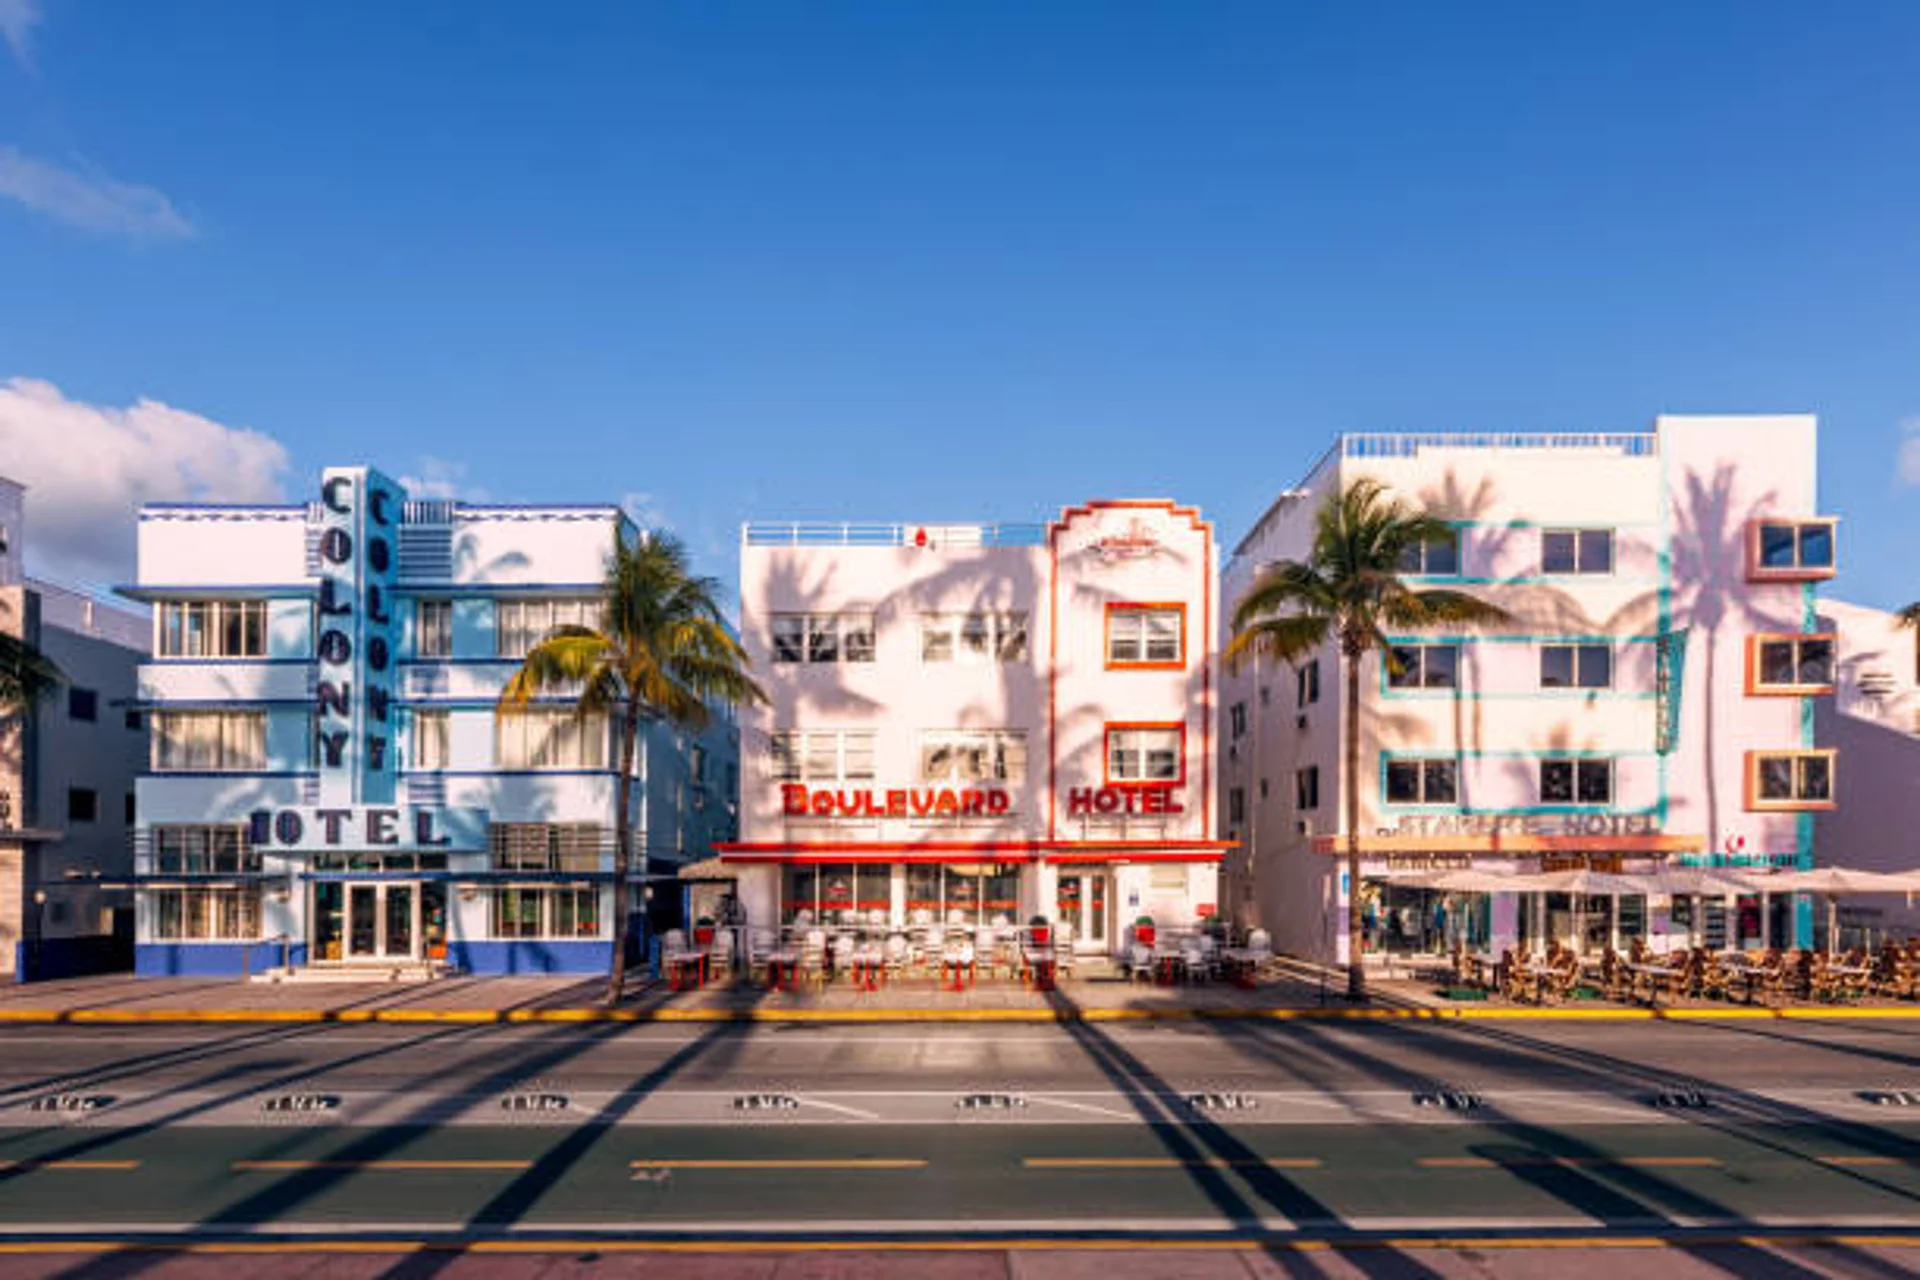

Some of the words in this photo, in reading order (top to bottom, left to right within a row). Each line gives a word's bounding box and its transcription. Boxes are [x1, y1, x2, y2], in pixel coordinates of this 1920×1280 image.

[318, 476, 352, 769] COLONY
[781, 783, 1010, 817] BOULEVARD
[1068, 787, 1184, 814] HOTEL
[250, 808, 452, 846] HOTEL
